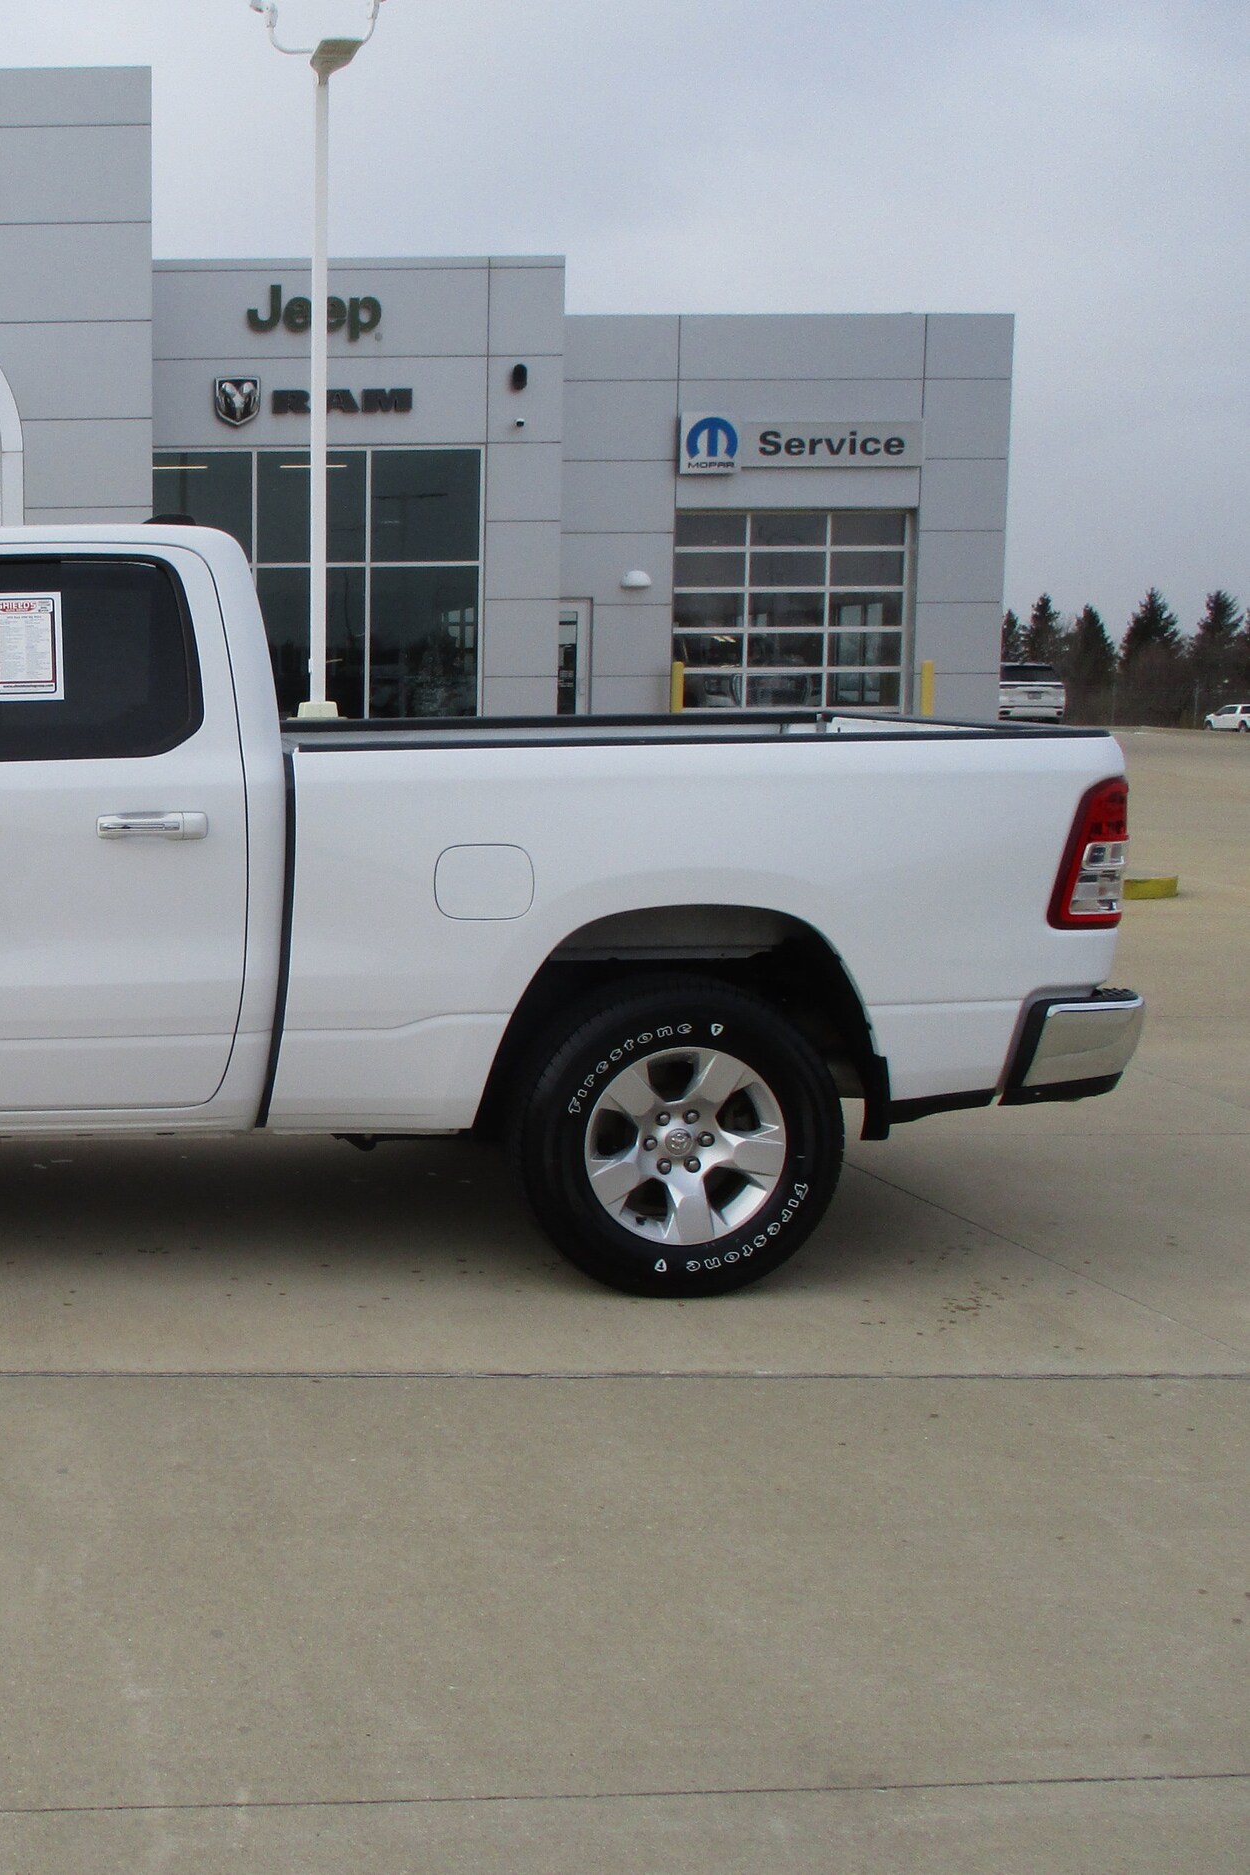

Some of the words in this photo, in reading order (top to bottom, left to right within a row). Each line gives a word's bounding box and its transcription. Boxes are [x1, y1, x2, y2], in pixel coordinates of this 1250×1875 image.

[247, 285, 382, 342] Jeep
[272, 388, 413, 414] RAM
[758, 430, 905, 456] Service
[567, 1022, 693, 1116] Firestone
[685, 1182, 810, 1272] Firestone
